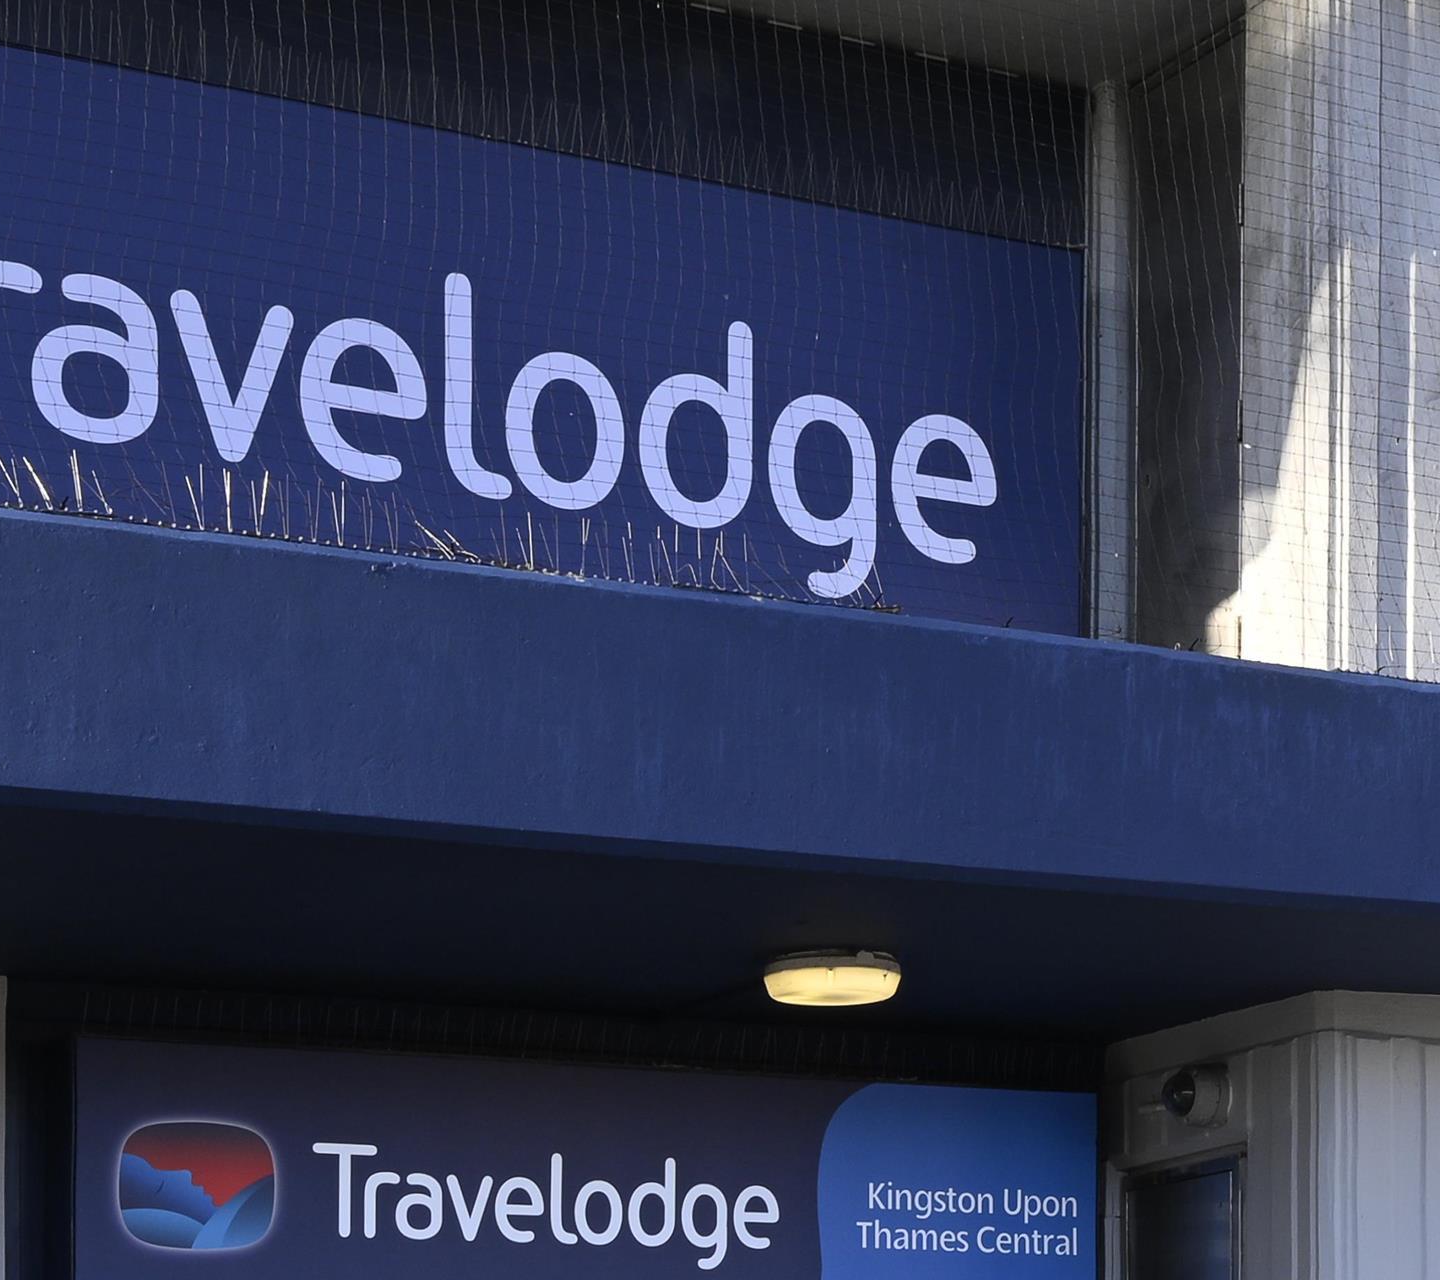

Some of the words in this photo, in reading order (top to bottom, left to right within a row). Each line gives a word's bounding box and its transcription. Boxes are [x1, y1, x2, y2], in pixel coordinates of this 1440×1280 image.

[312, 1141, 781, 1270] Travelodge
[868, 1181, 994, 1219] Kingston
[1003, 1188, 1078, 1223] Upon
[856, 1220, 969, 1252] Thames
[977, 1226, 1078, 1256] Central
